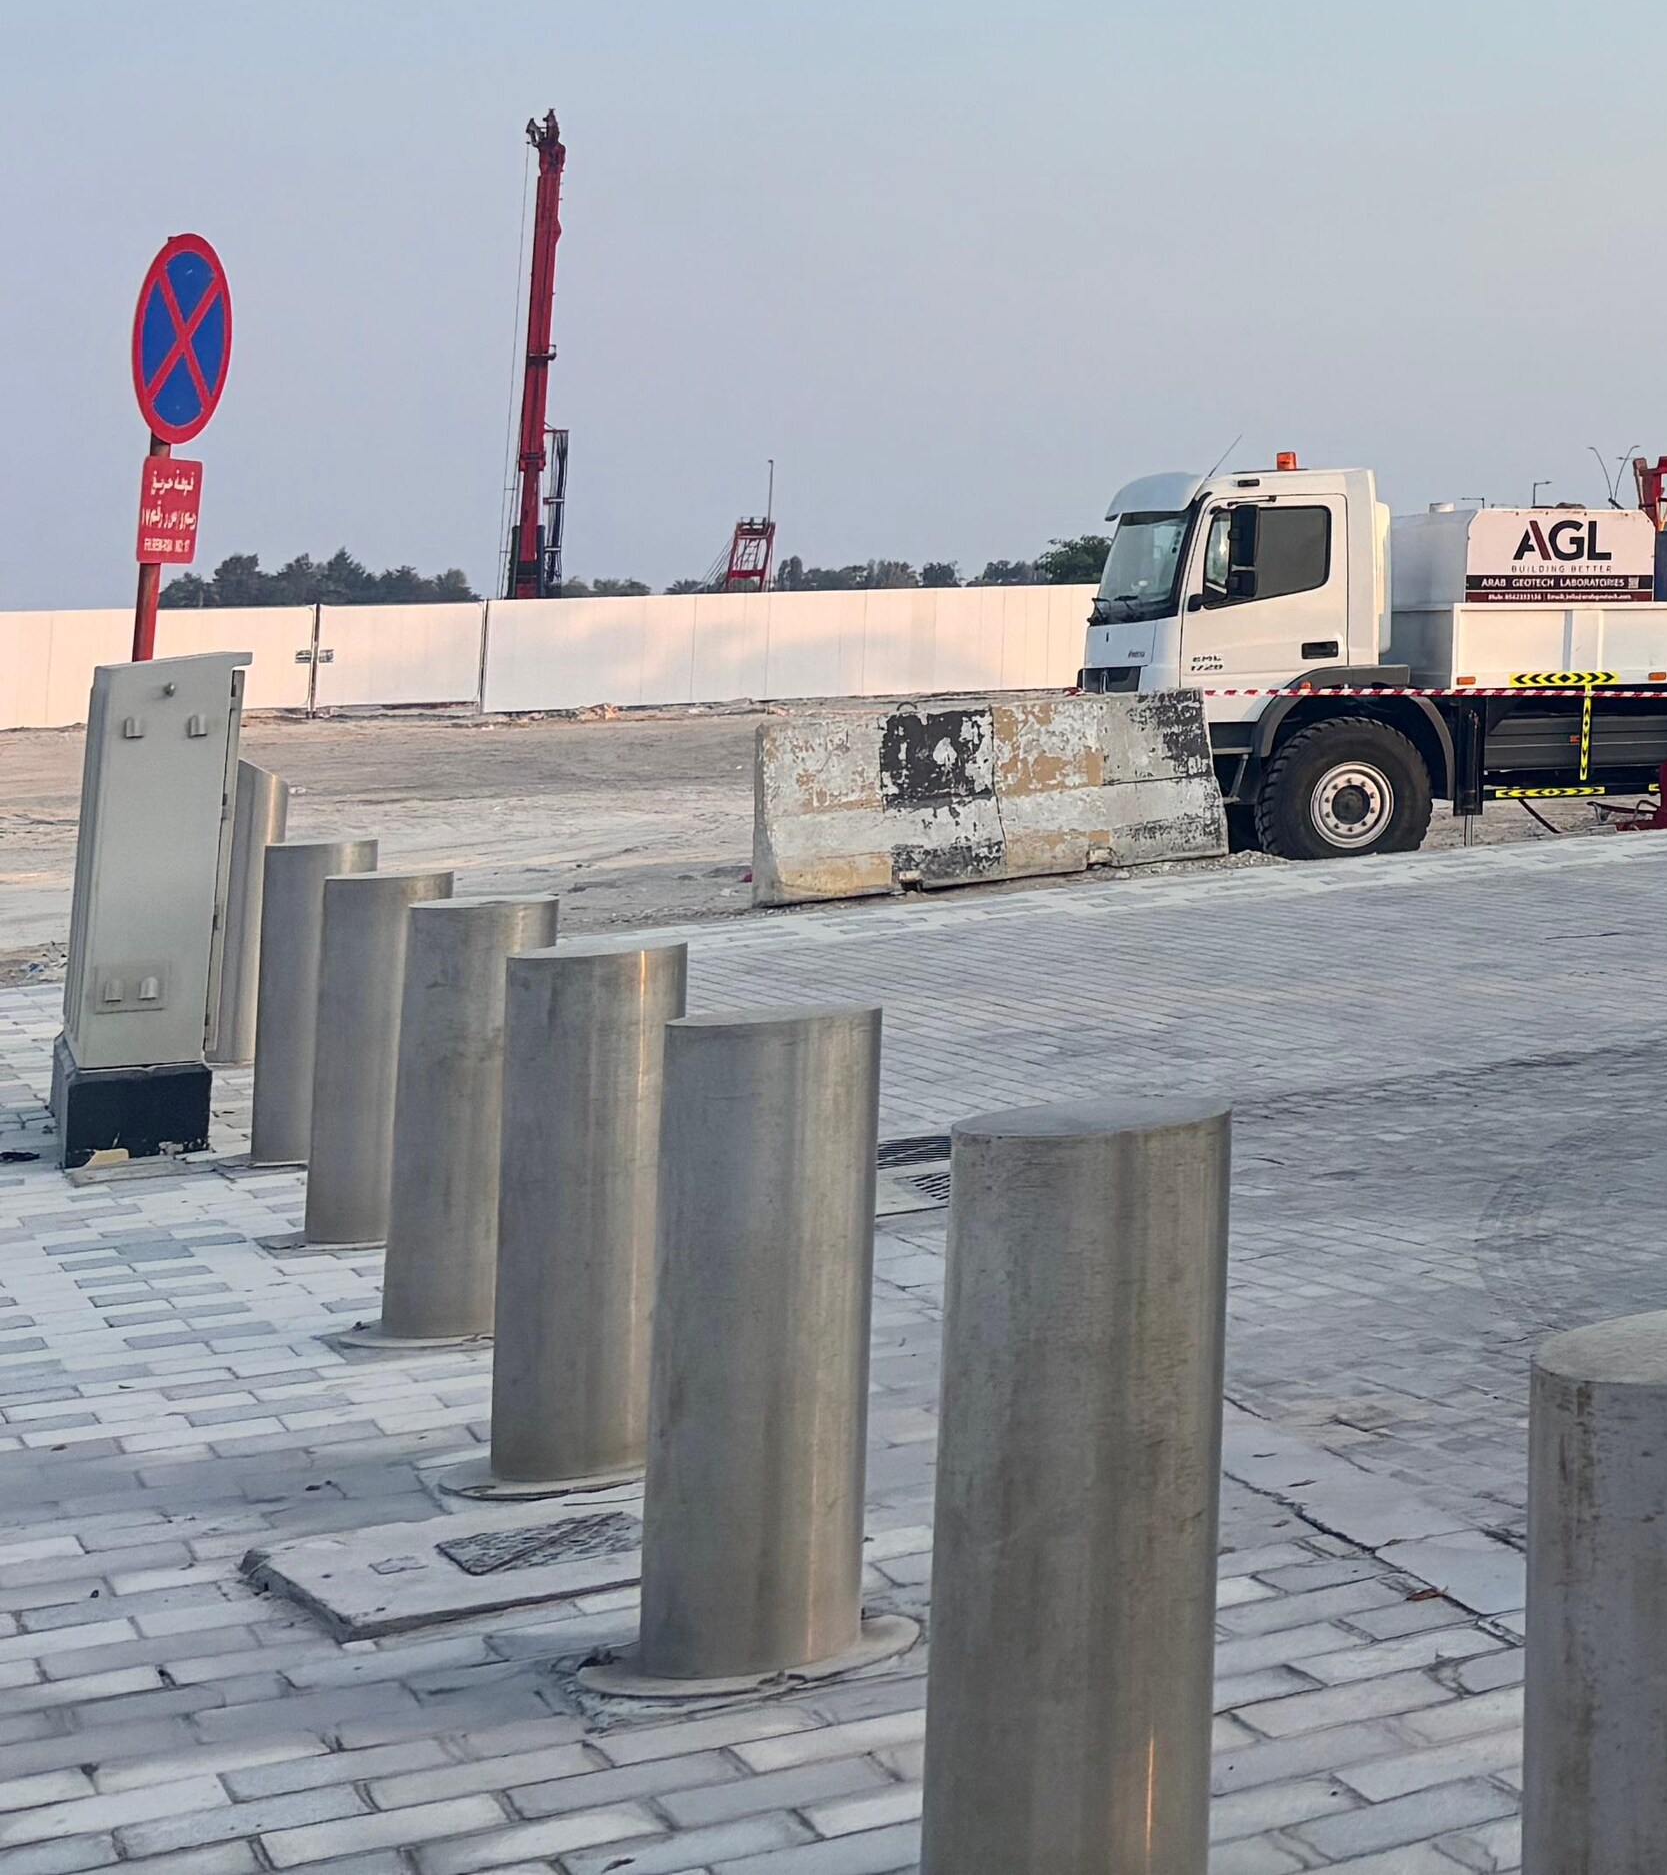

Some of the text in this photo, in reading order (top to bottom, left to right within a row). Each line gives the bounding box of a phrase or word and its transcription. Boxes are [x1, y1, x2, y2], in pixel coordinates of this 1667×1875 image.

[1512, 520, 1612, 561] AGL
[1511, 565, 1612, 574] BUILDING BETTER
[1481, 577, 1625, 588] ARAB GEOTECH LABORATORIES
